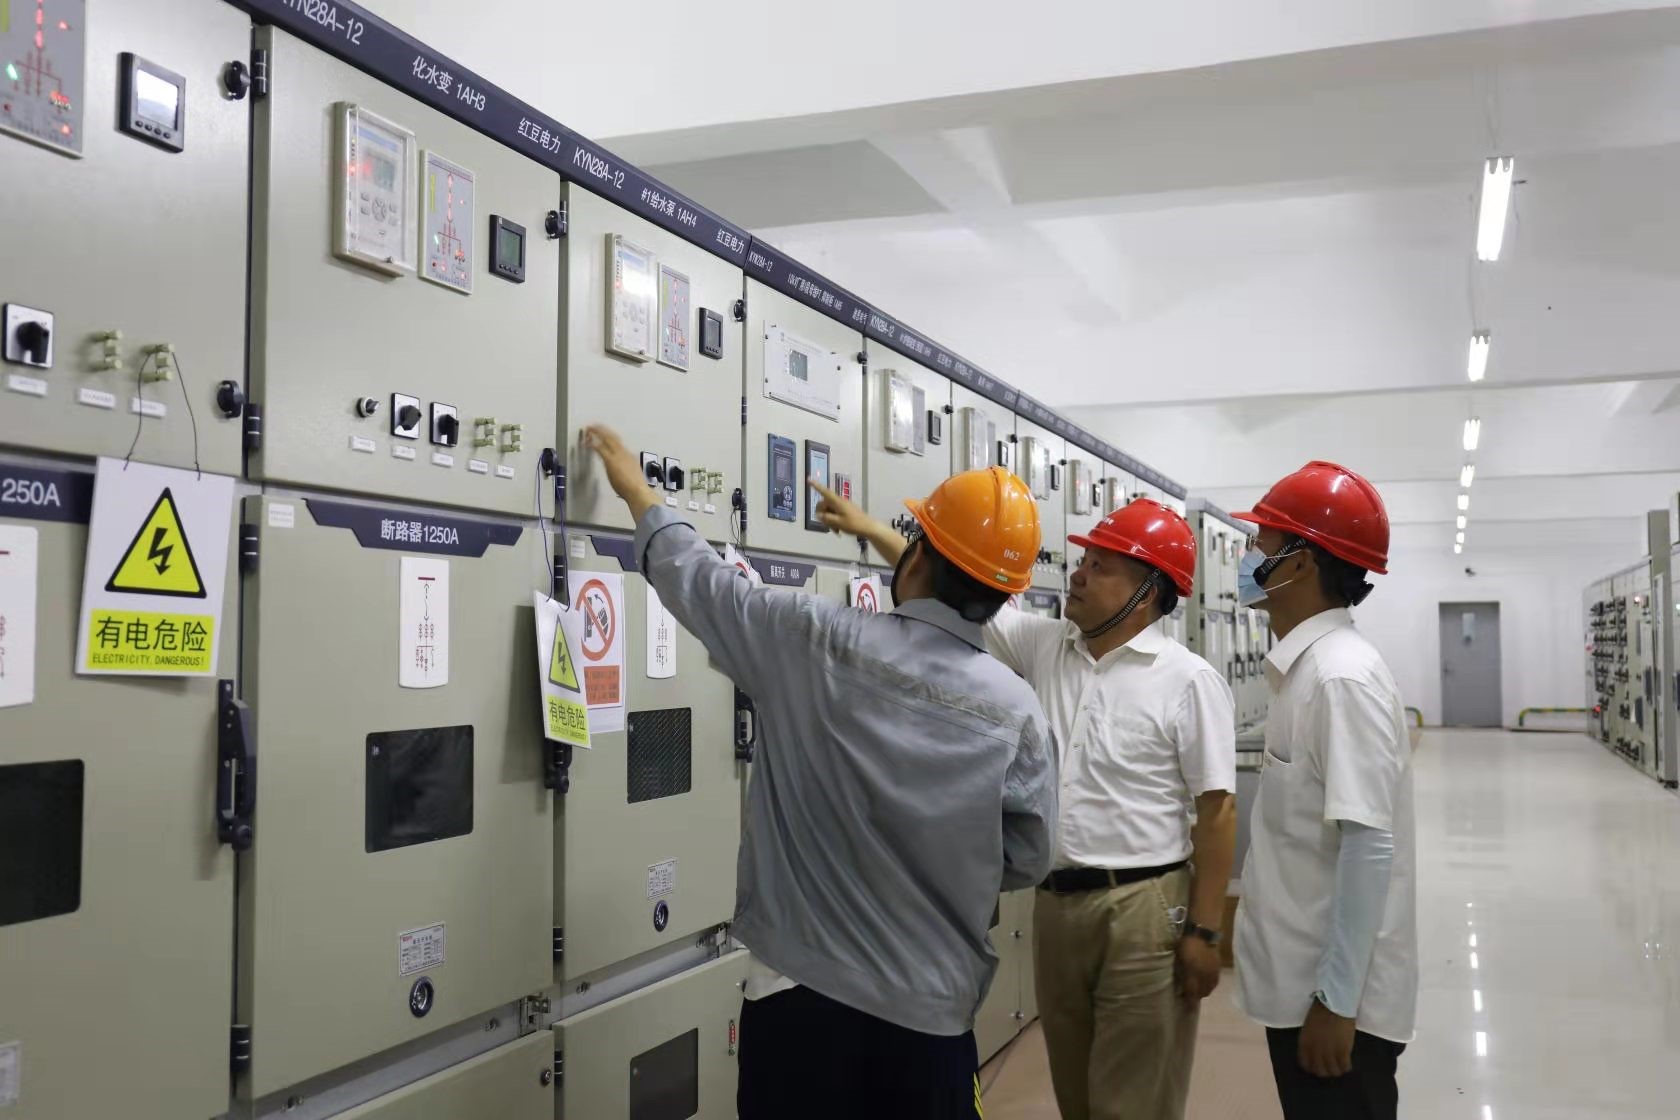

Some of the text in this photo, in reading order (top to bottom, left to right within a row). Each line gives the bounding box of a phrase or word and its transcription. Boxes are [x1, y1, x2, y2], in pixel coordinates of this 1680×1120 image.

[283, 0, 364, 45] N28A-12
[411, 56, 486, 111] 化水变 1AH3
[518, 117, 561, 154] 红豆电力
[573, 147, 625, 189] KYN28A-12
[641, 188, 698, 228] #1给水泵 1AH4
[716, 228, 744, 254] 红豆电力
[749, 251, 773, 272] KYN28A-12
[381, 518, 459, 545] 断路器1250A
[1004, 549, 1020, 561] 062
[95, 616, 208, 652] 有电危险
[154, 655, 204, 667] DANGEROUS!
[549, 700, 586, 730] 有电危险
